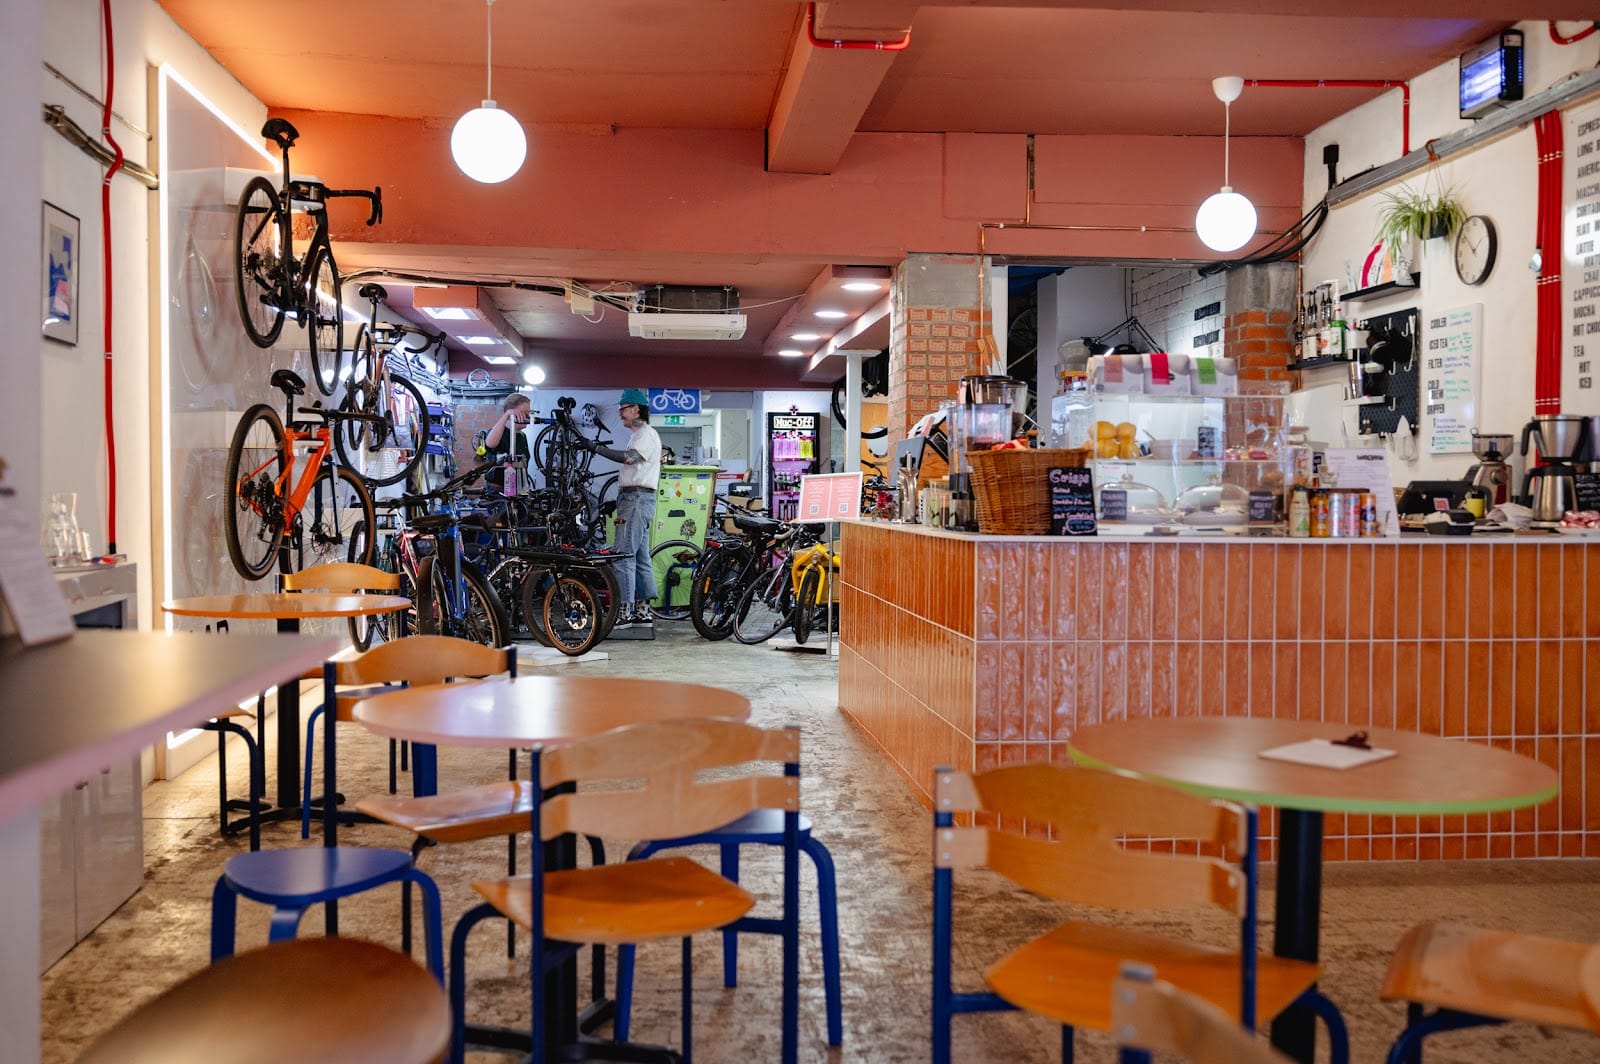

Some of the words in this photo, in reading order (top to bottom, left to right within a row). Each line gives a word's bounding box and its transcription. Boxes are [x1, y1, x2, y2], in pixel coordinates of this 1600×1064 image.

[1573, 304, 1595, 319] MOCHA
[1430, 317, 1447, 330] COOLER
[1573, 323, 1584, 337] HOT
[1440, 338, 1448, 349] TEA
[1573, 345, 1584, 357] TEA
[1428, 358, 1443, 369] FILTER
[1579, 361, 1590, 374] HOT
[1579, 377, 1592, 389] ICED
[775, 417, 813, 428] Muc-Off
